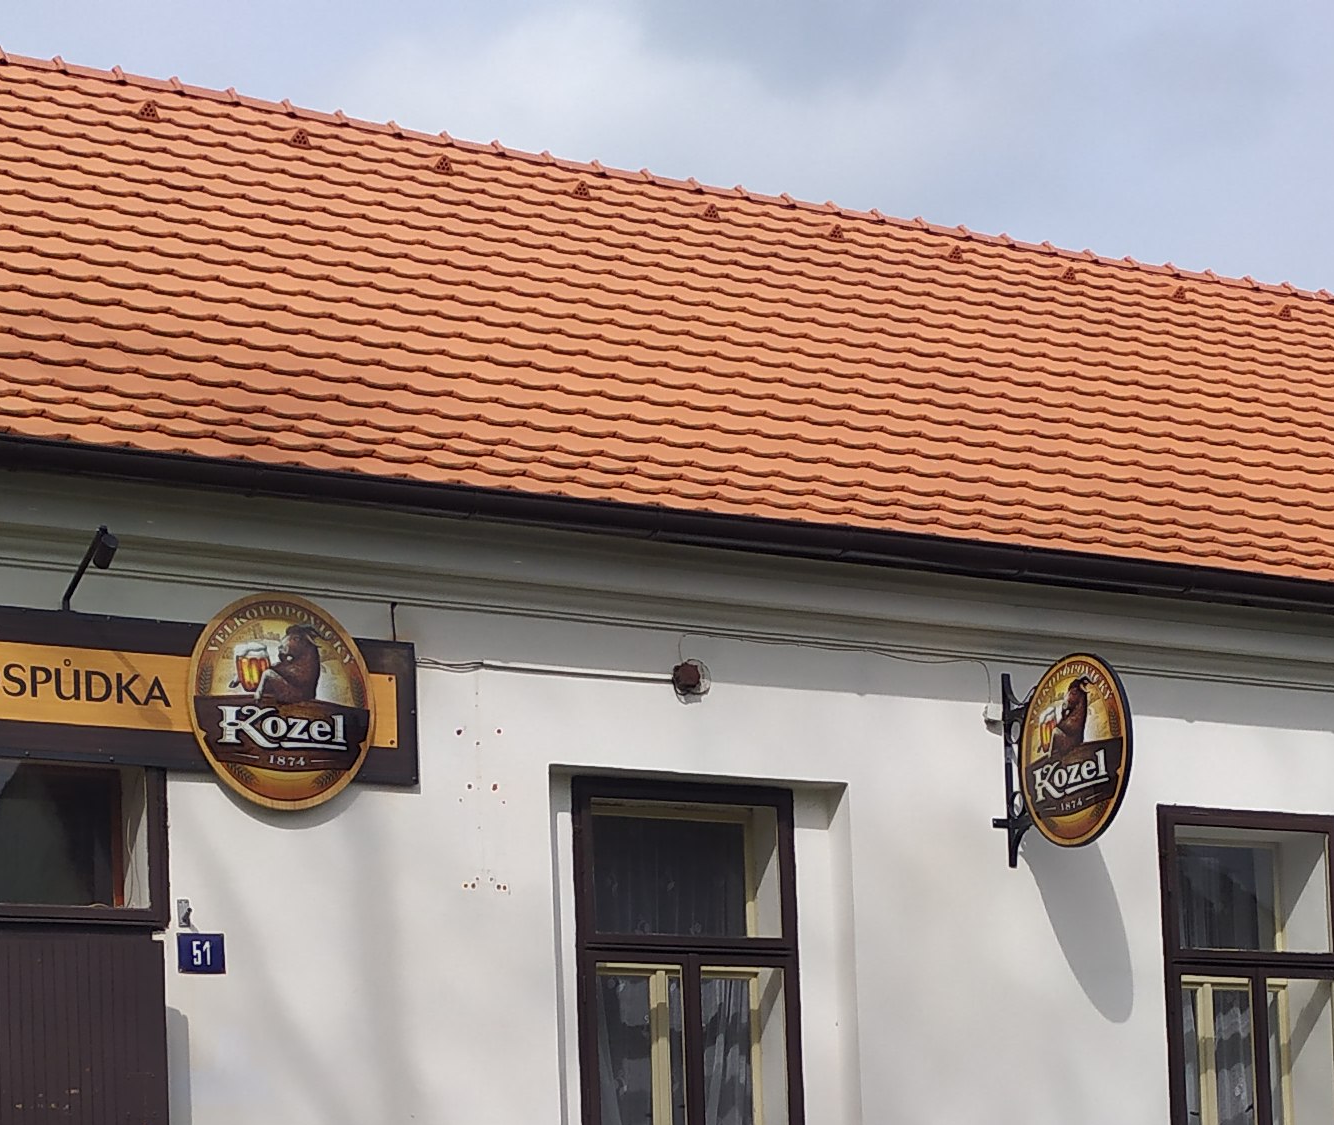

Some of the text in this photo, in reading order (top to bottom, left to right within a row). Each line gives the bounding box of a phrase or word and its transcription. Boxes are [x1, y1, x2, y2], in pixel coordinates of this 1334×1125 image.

[217, 705, 348, 750] Kozel
[269, 754, 306, 766] 1874
[1032, 749, 1109, 802] Kozel
[1060, 799, 1083, 812] 1874
[192, 940, 211, 966] 51
